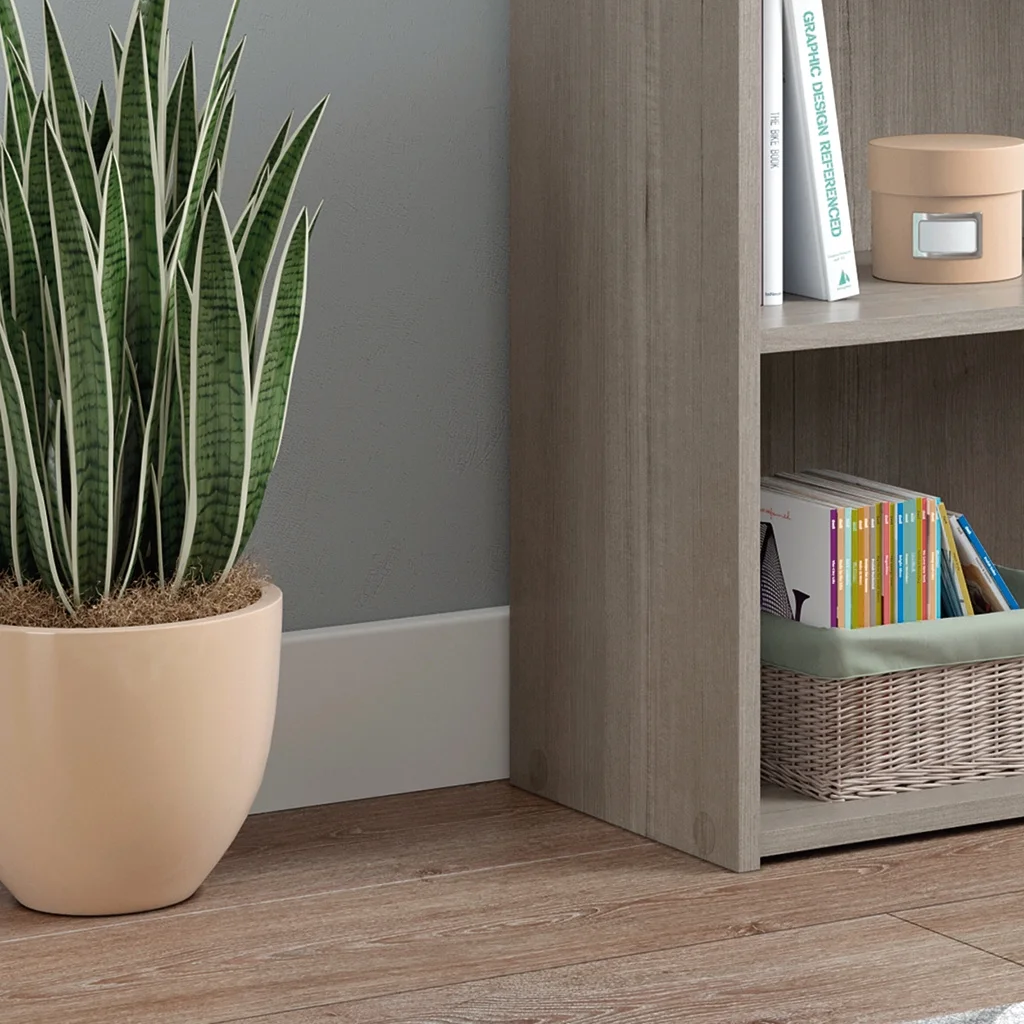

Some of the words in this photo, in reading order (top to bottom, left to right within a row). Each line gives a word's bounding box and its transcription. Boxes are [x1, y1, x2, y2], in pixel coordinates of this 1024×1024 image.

[803, 11, 822, 78] GRAPHIC
[770, 112, 780, 127] THE
[812, 81, 829, 136] DESIGN
[770, 129, 780, 146] BIKE
[770, 148, 780, 169] BOOK
[819, 140, 842, 238] REFERENCED
